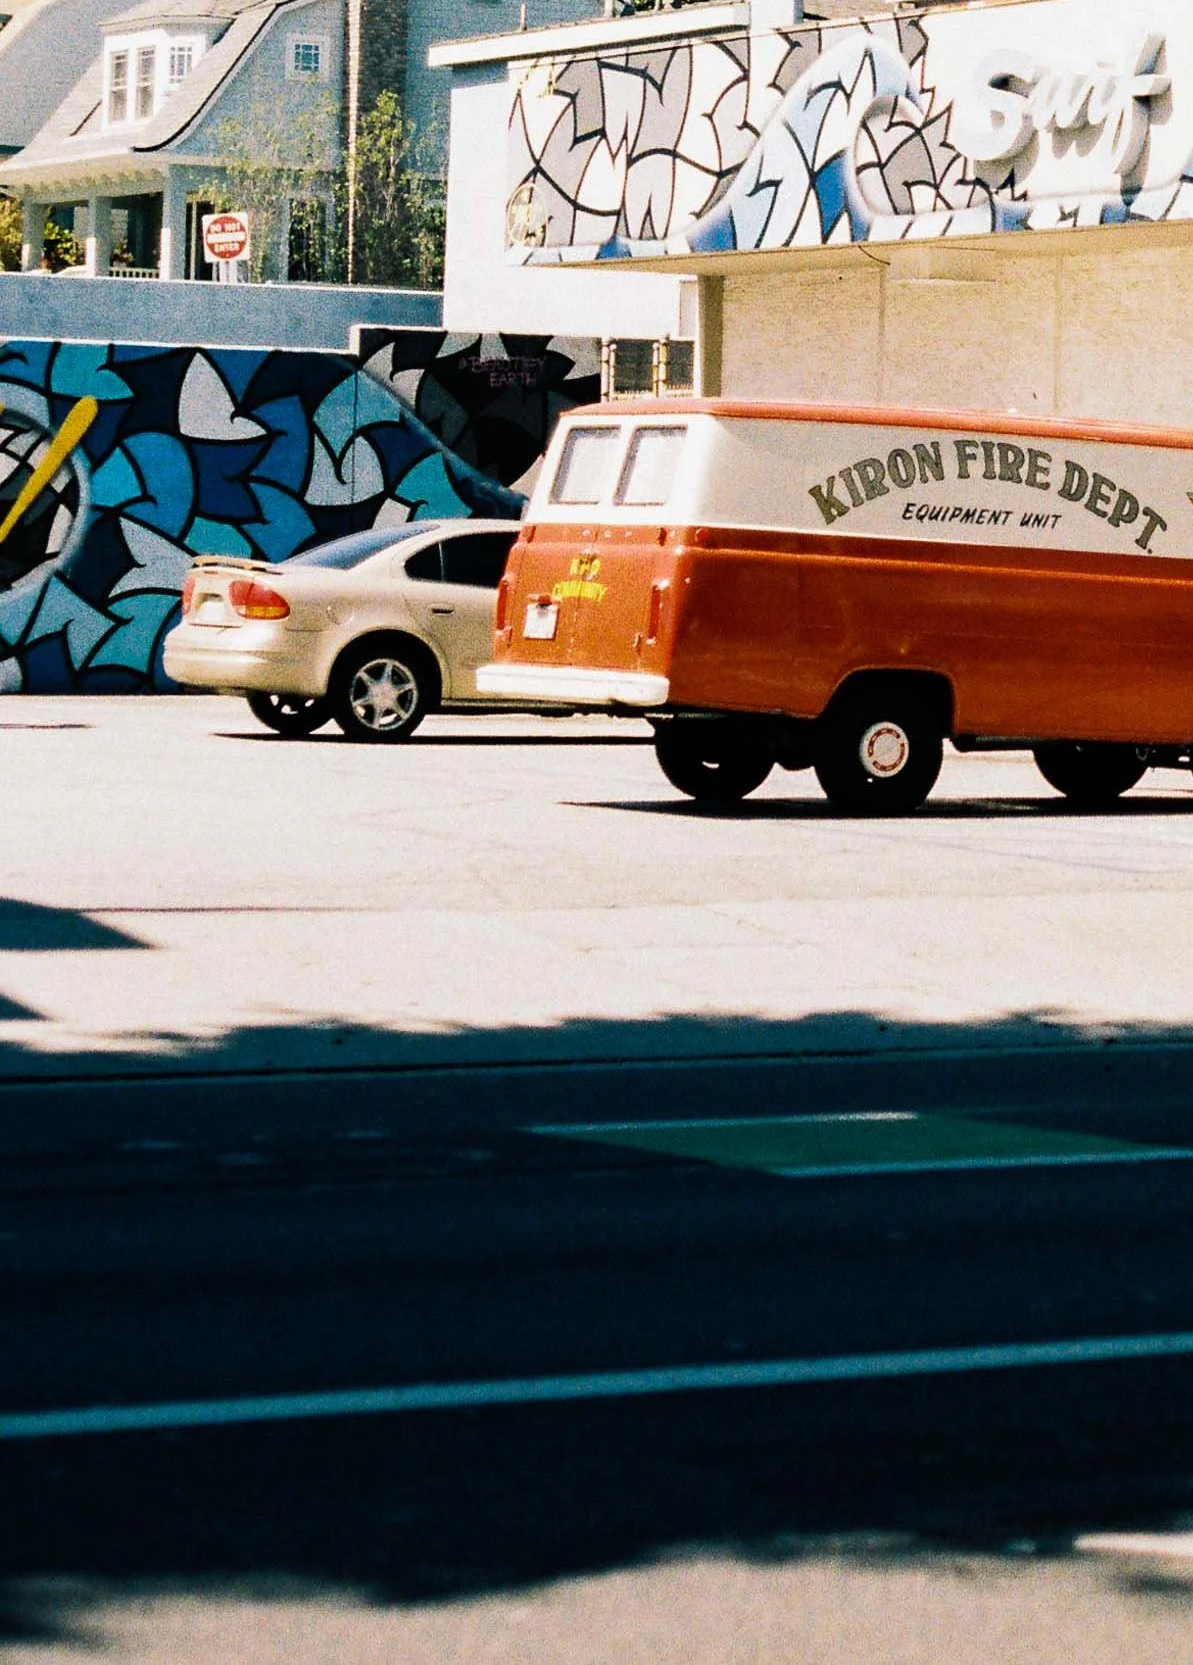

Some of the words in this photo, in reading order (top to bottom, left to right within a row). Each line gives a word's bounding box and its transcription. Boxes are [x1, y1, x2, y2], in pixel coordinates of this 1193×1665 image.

[950, 33, 1171, 174] Surf
[809, 440, 945, 525] KIRON
[954, 439, 1052, 490] FIRE
[1057, 460, 1168, 554] DEPT.
[902, 502, 1014, 526] EQUIPMENT
[1019, 511, 1063, 530] UNIT
